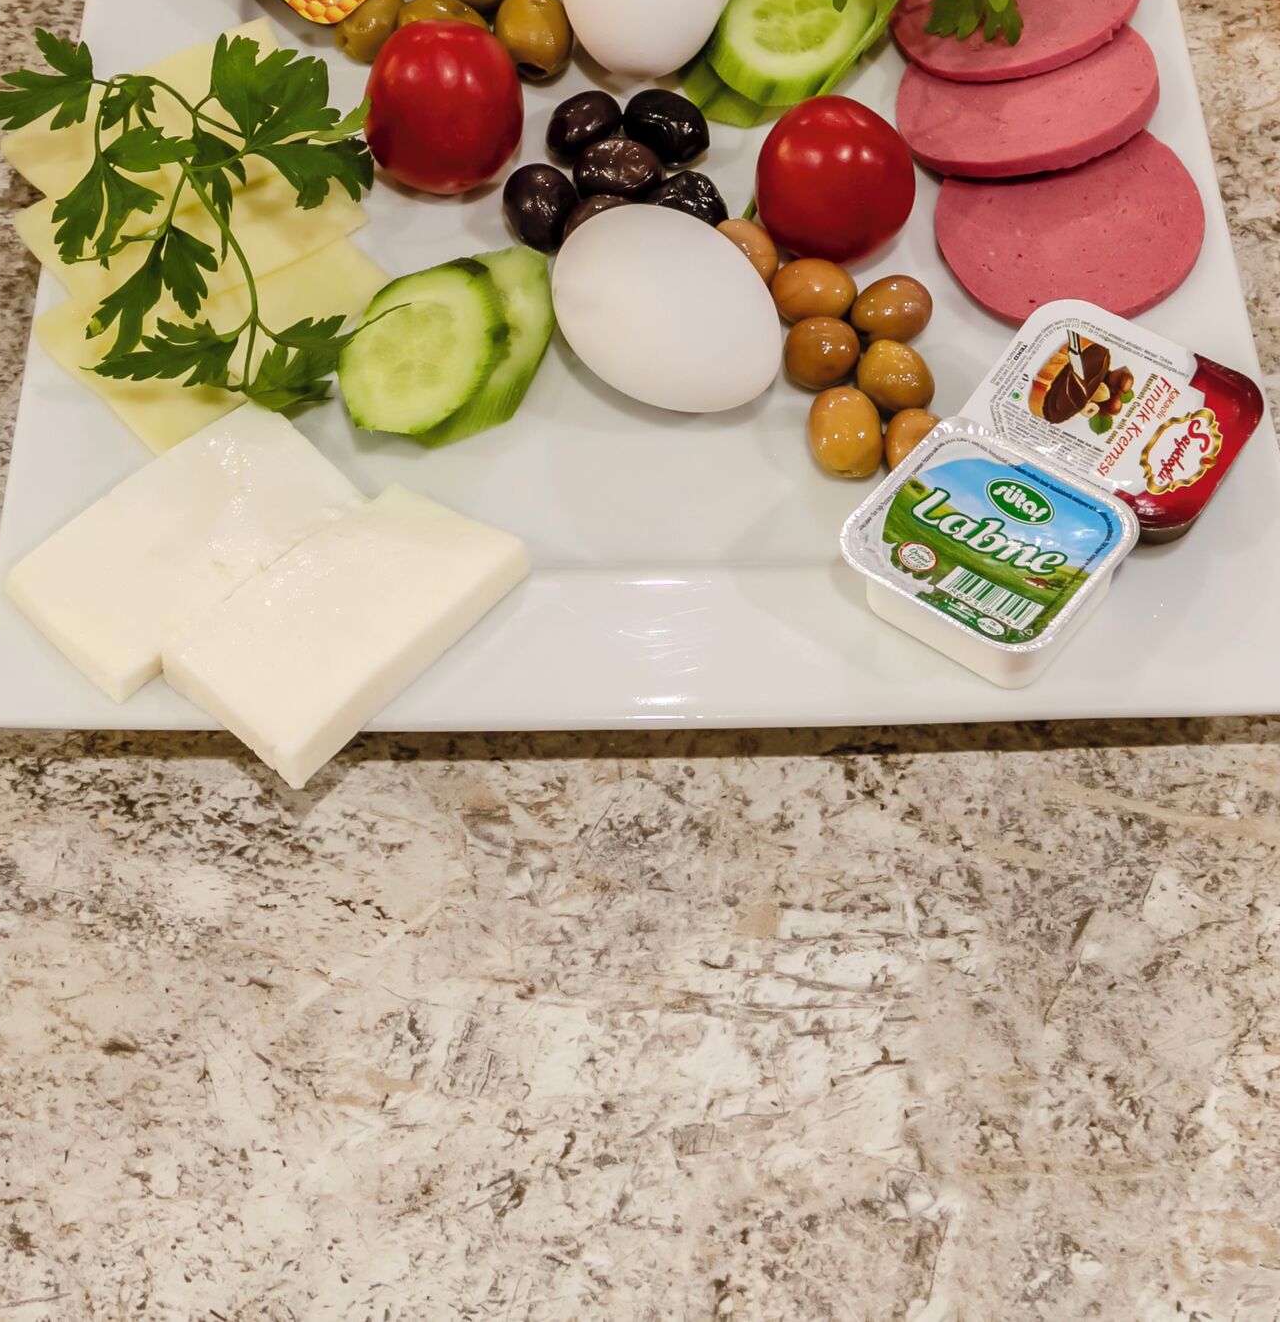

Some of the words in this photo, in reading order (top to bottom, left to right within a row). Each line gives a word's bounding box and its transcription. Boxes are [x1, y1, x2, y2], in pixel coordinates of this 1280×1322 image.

[1136, 376, 1172, 423] Fındık
[1097, 421, 1142, 477] Kreması
[912, 487, 1067, 575] Labne
